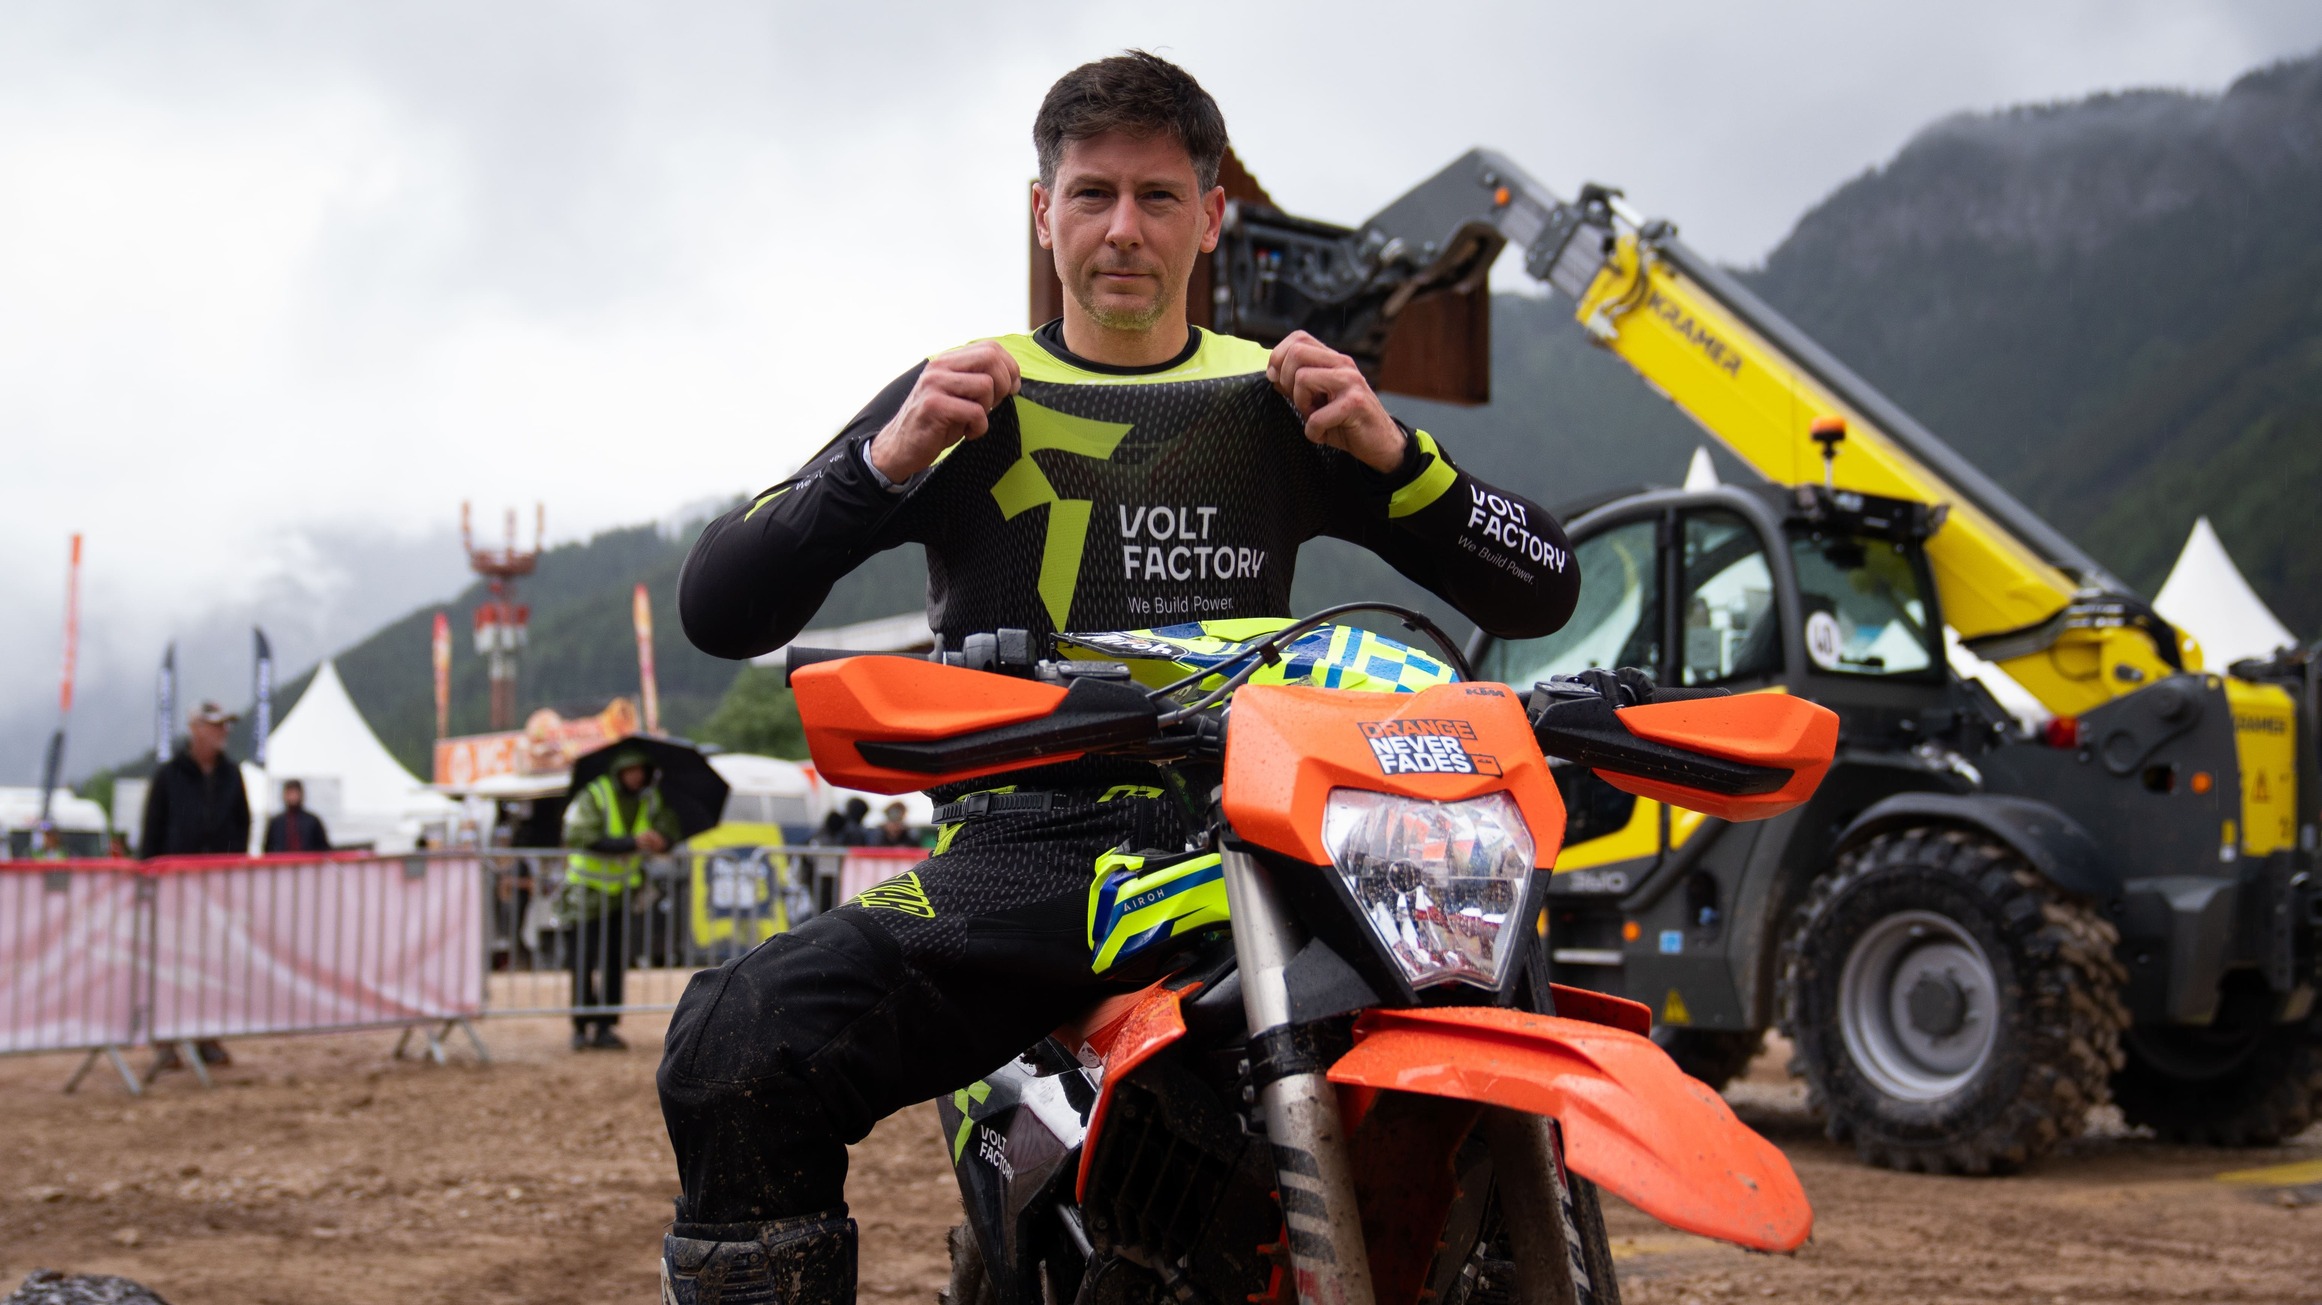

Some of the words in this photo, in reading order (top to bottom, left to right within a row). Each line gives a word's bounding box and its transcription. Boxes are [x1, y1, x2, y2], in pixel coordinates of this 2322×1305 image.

[1648, 291, 1743, 377] KRAMER
[1470, 484, 1527, 526] VOLT
[1119, 504, 1217, 541] VOLT
[1467, 506, 1566, 574] FACTORY
[1123, 545, 1265, 581] FACTORY
[1458, 535, 1477, 552] We
[1478, 546, 1508, 568] Build
[1506, 560, 1535, 585] Power.
[1128, 597, 1150, 614] We
[1155, 597, 1188, 614] Build
[1466, 687, 1505, 698] KTM
[1361, 719, 1474, 739] ORANGE
[1369, 735, 1464, 754] NEVER
[1378, 753, 1472, 773] FADES
[1124, 889, 1164, 911] AIROH
[981, 1124, 1007, 1153] VOLT
[980, 1142, 1015, 1183] FACTORY
